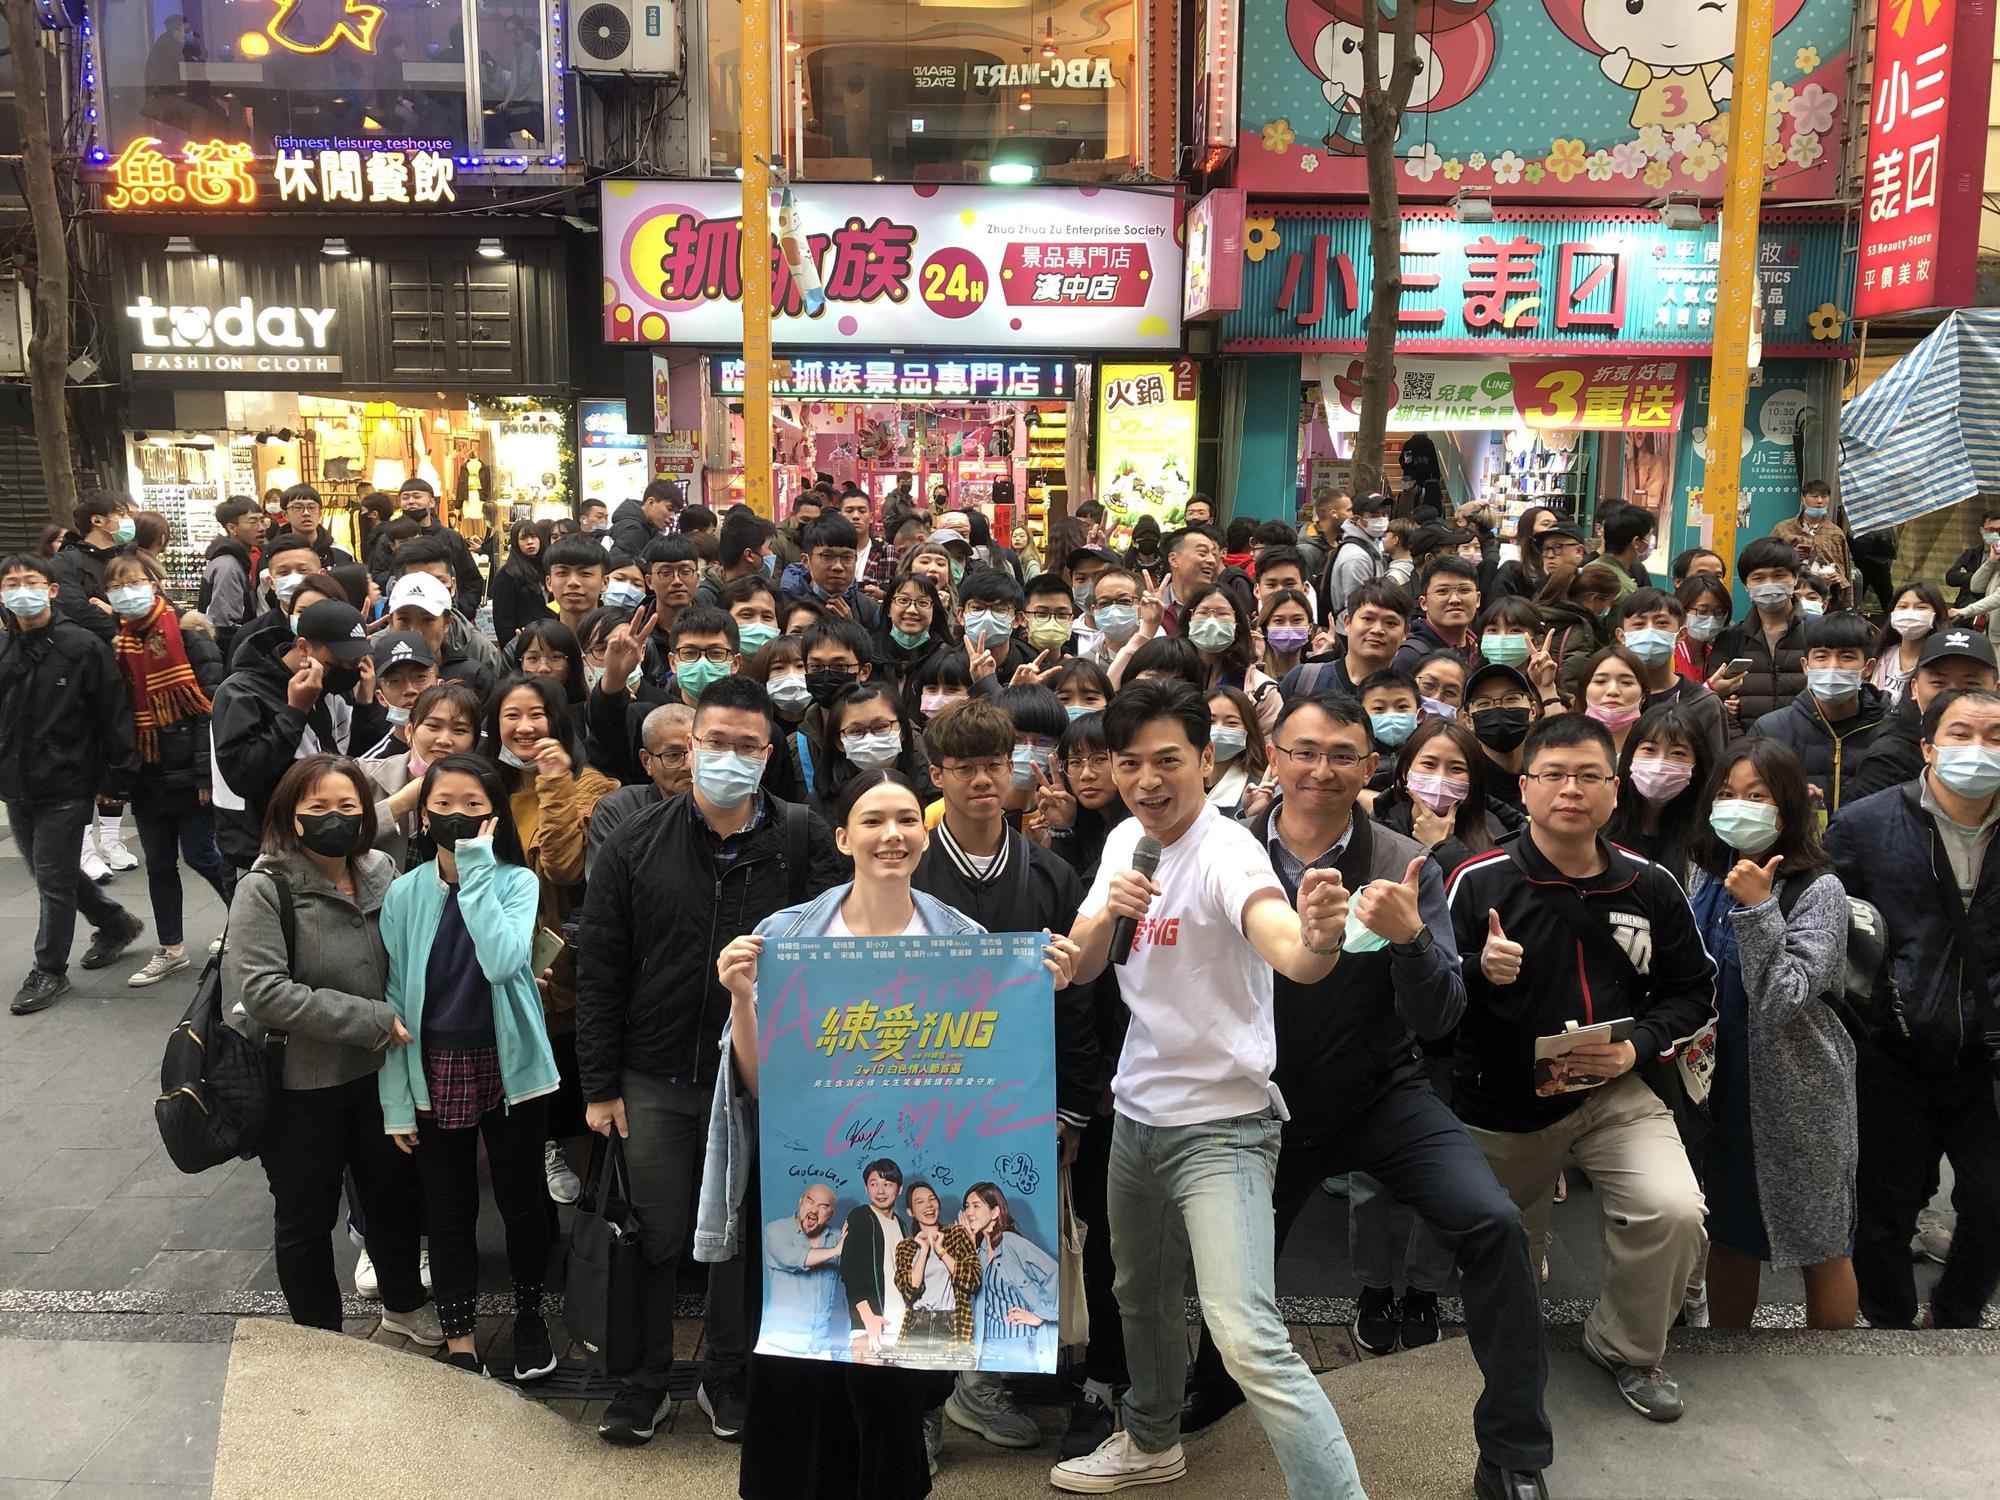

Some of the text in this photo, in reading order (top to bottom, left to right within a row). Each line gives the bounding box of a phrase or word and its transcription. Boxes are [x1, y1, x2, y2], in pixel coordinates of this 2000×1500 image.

[274, 135, 453, 151] fishnest leisure teshouse
[987, 224, 1167, 237] Zhua Zhua Zu Enterprise Society
[1878, 239, 1907, 254] Beauty
[1908, 233, 1933, 247] Store
[1021, 246, 1132, 269] 景品專門店
[924, 262, 984, 304] 24H
[1863, 257, 1931, 292] 平價美妝
[1032, 273, 1120, 301] 漢中店
[144, 356, 329, 371] FASHION CLOTH
[1108, 376, 1164, 410] 火鍋
[1485, 379, 1511, 391] LINE
[1768, 407, 1796, 417] 10:30
[1752, 450, 1796, 466] 小三美
